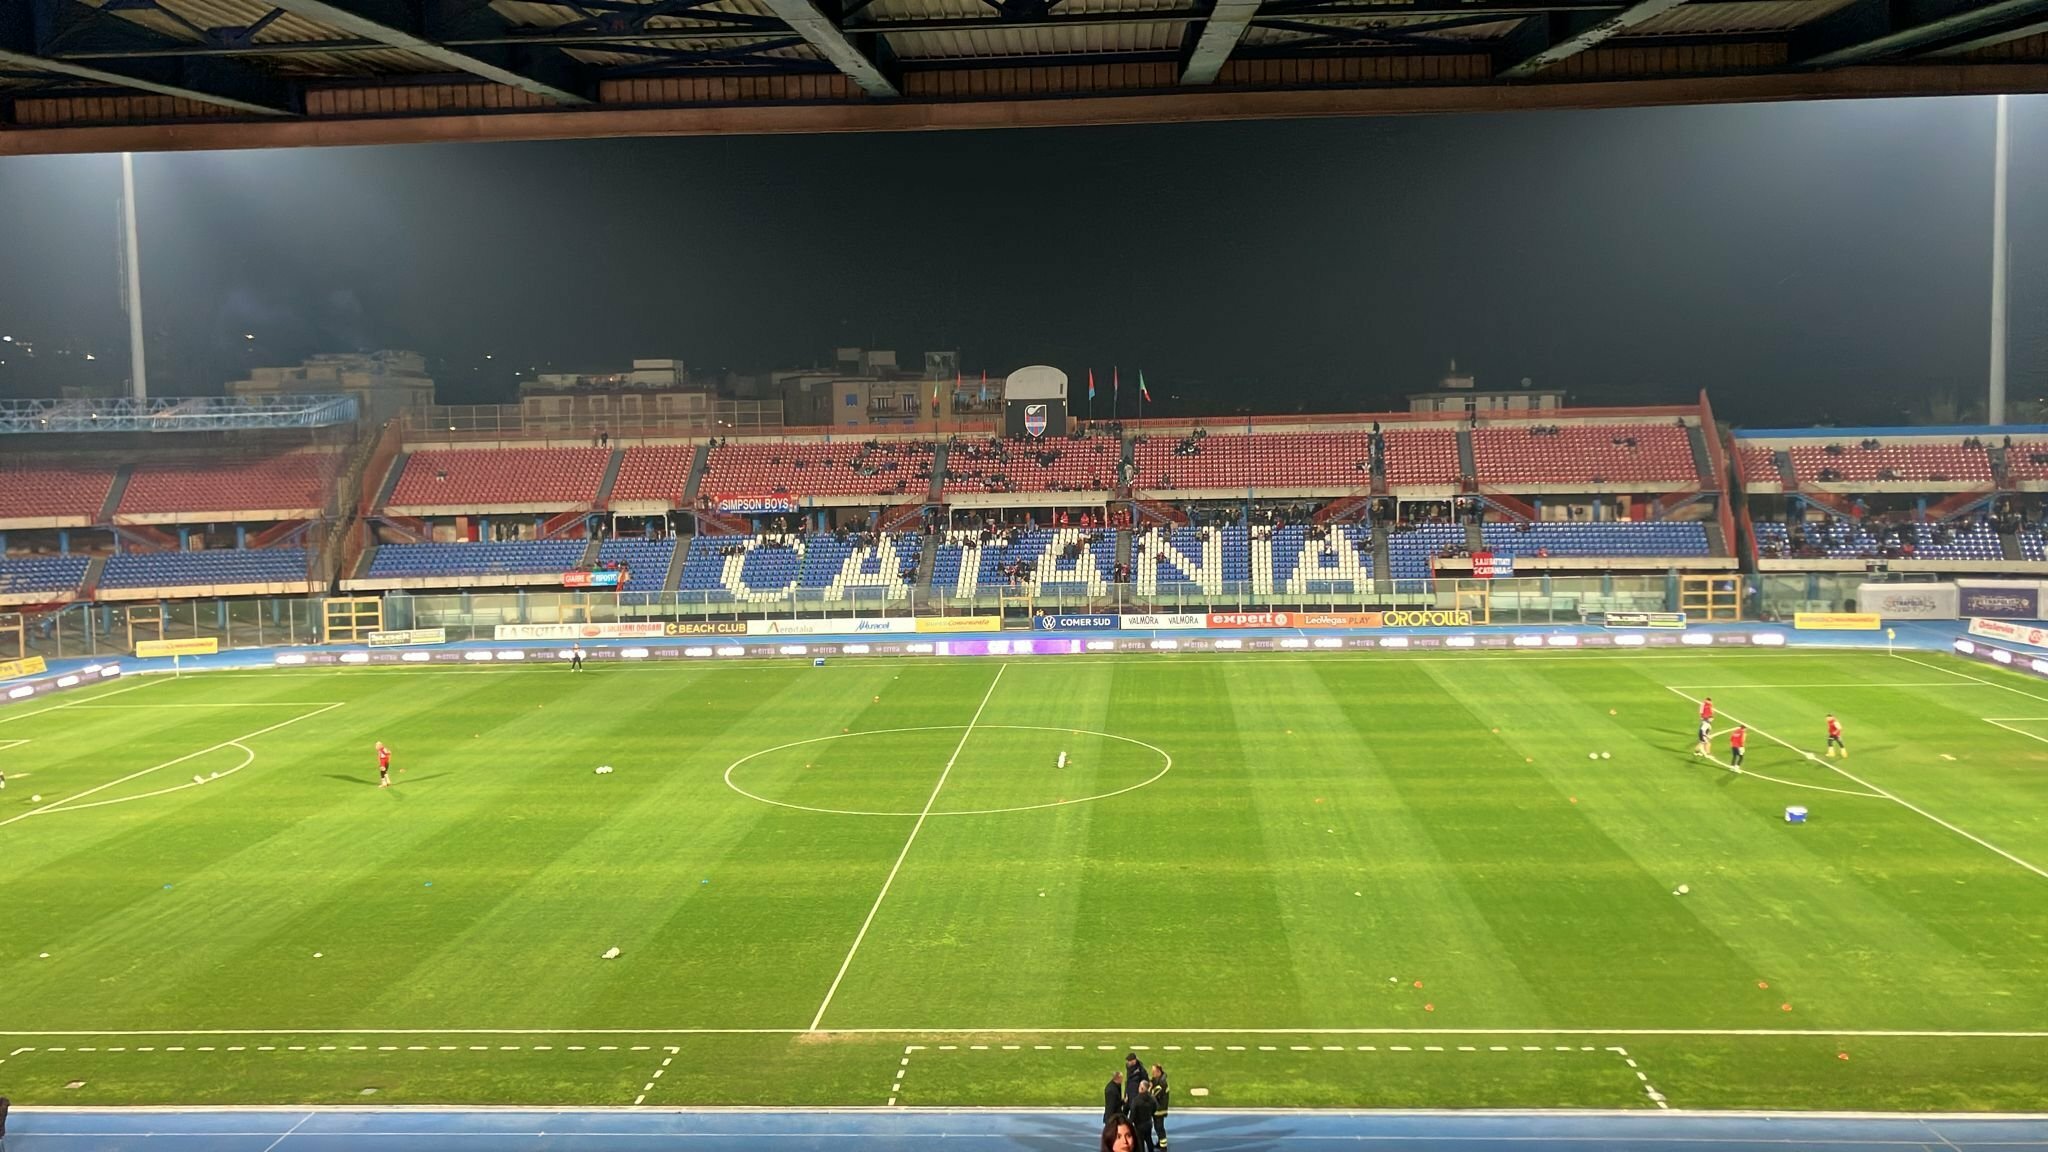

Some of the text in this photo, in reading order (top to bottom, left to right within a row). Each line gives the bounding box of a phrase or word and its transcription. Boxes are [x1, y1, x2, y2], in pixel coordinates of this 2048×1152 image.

[722, 497, 789, 511] SIMPSON BOYS
[1060, 618, 1091, 627] COMER
[1093, 618, 1111, 626] SUD
[1128, 615, 1199, 625] VALMORA VALMORA
[1212, 612, 1272, 625] expert
[1305, 615, 1370, 625] LeoVegas PLAY
[679, 623, 715, 633] BEACH
[718, 623, 746, 633] CLUB
